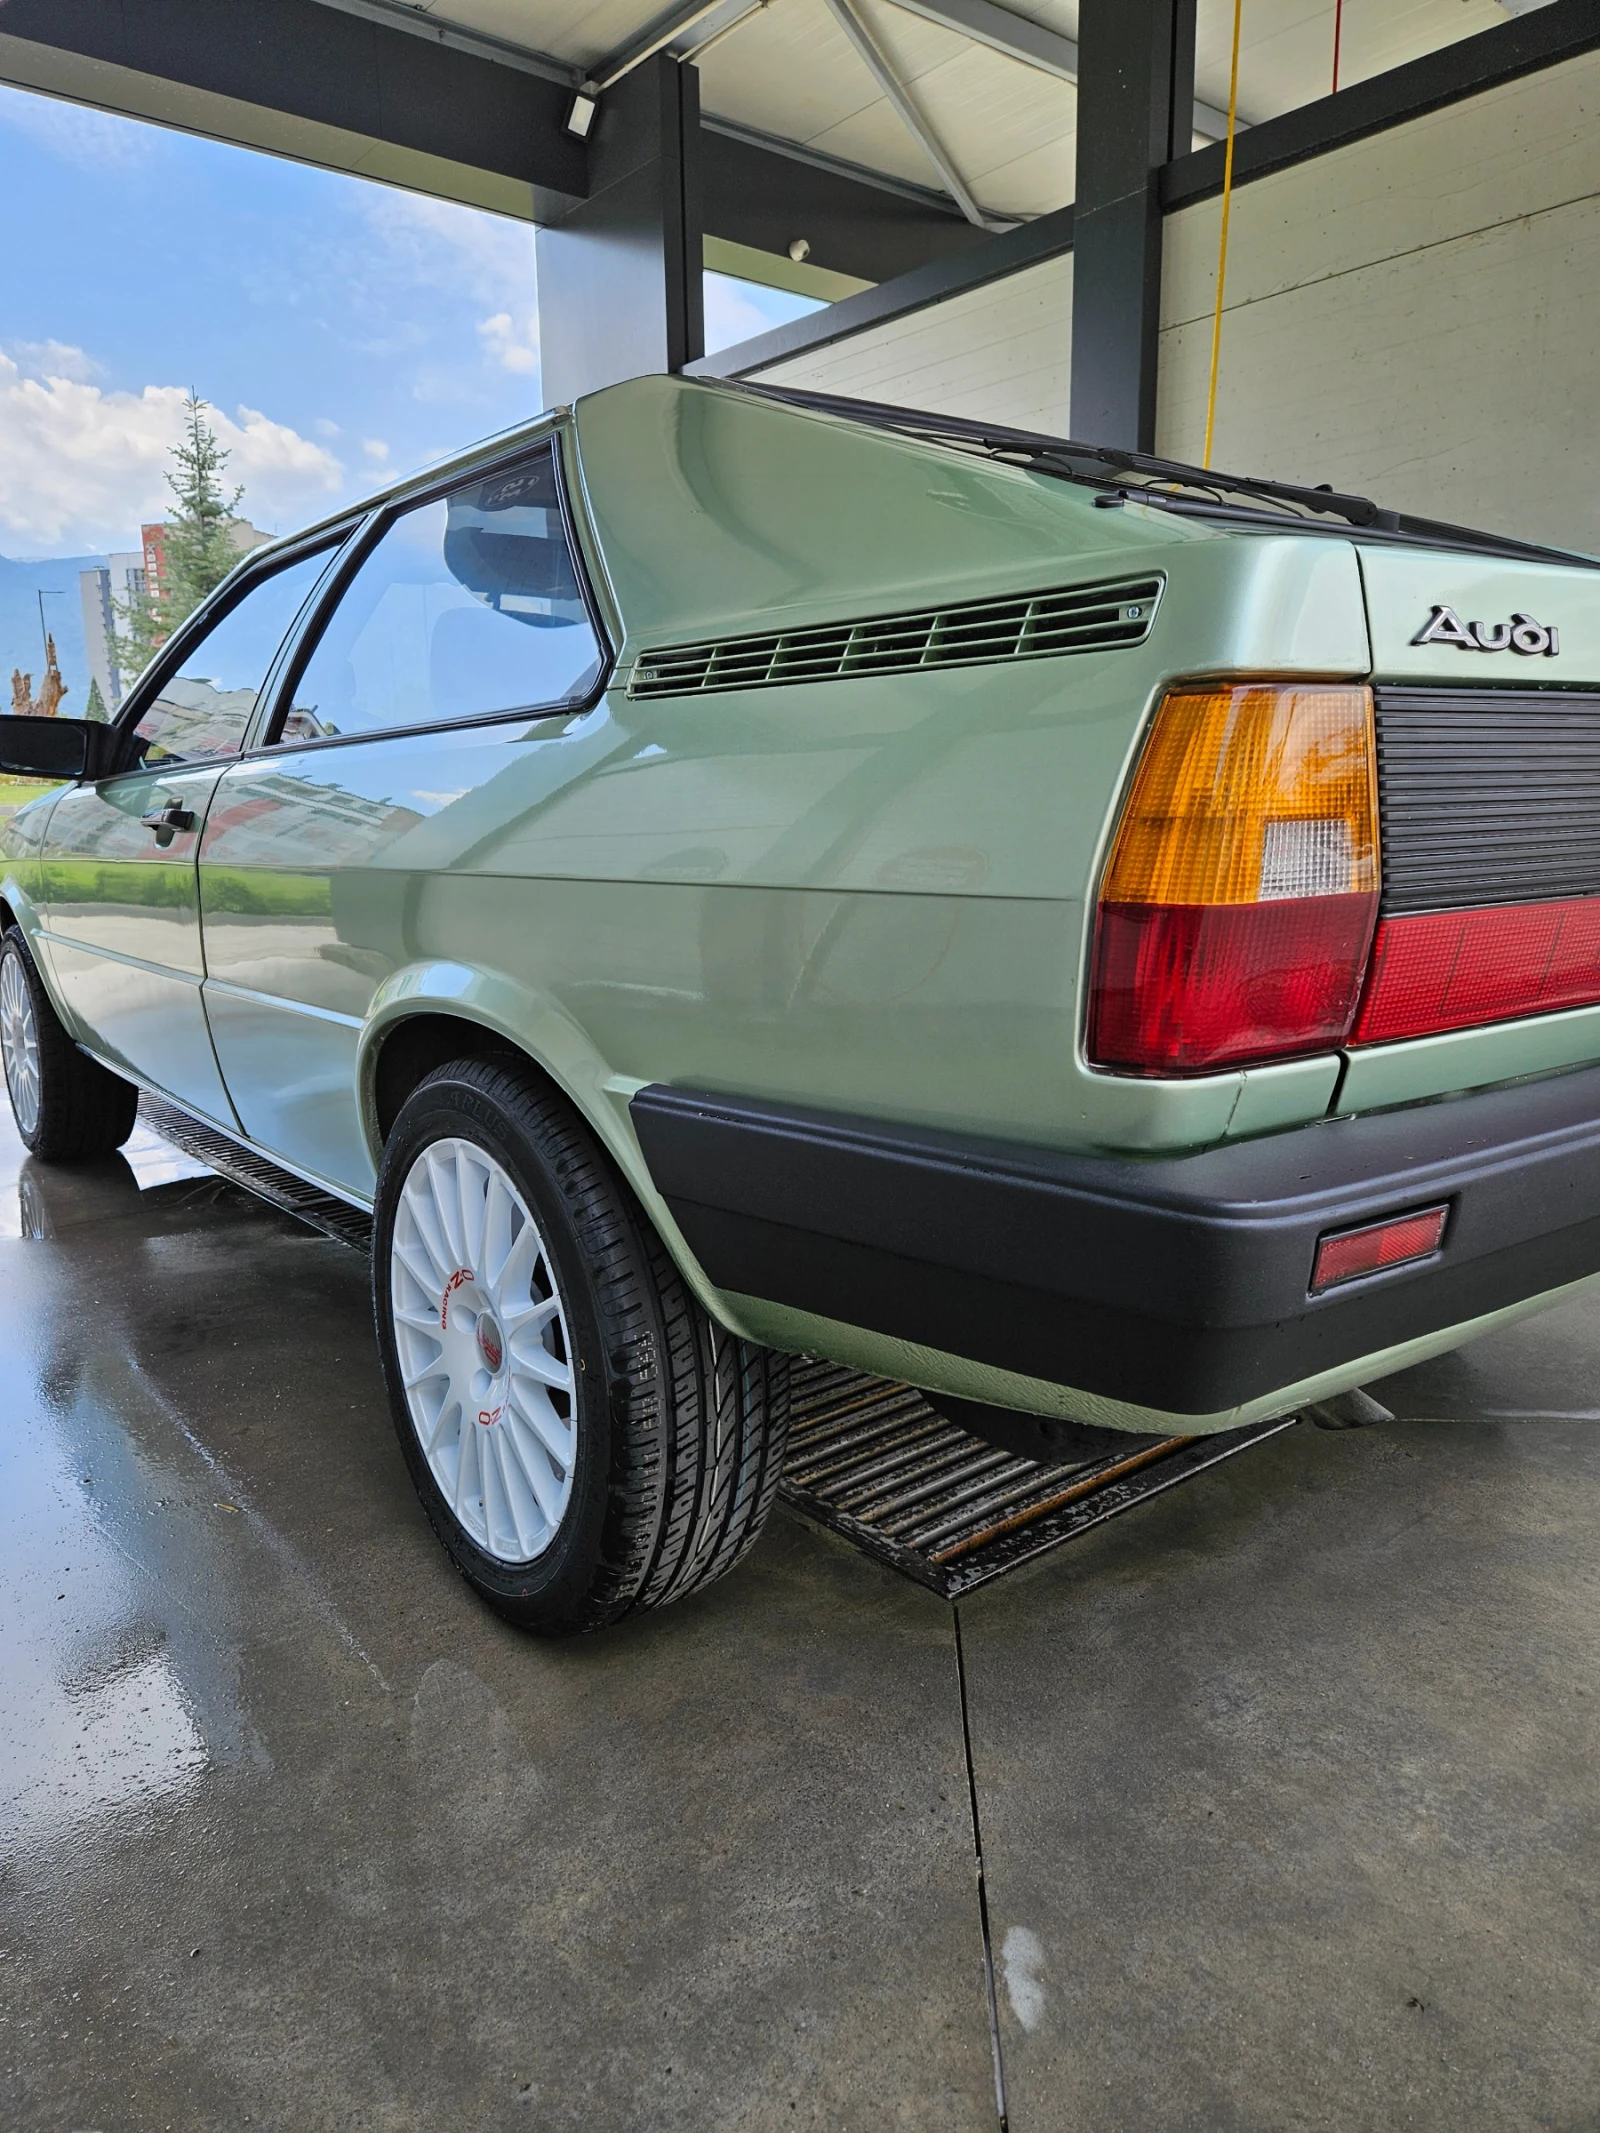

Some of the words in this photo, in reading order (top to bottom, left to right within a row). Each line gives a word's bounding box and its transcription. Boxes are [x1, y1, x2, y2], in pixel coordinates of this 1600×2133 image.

[1409, 605, 1559, 657] Audi
[446, 1091, 506, 1140] APLUS
[441, 1284, 452, 1330] RACING
